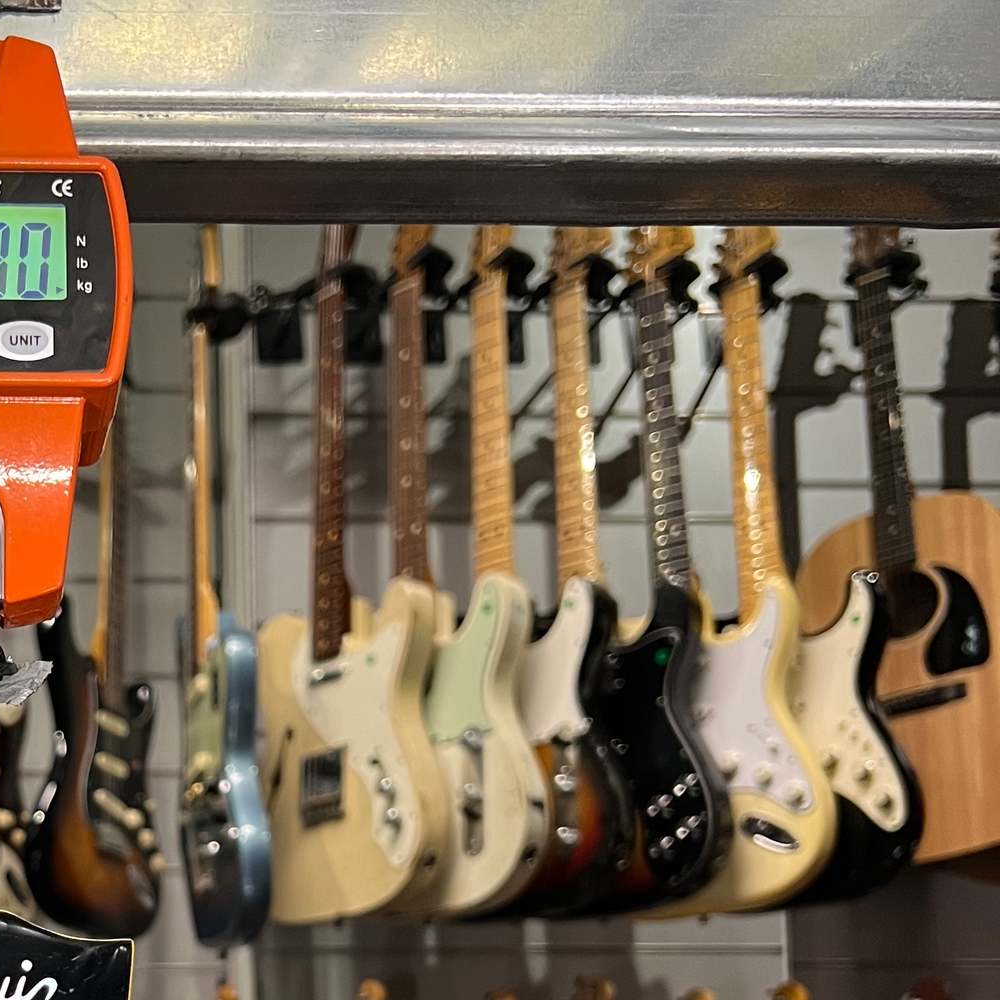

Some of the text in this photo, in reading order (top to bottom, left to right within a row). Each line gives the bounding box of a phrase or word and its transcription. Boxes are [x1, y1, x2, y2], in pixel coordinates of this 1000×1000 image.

[76, 235, 87, 247] N
[76, 257, 89, 270] lb
[76, 279, 93, 294] kg
[9, 333, 41, 347] UNIT
